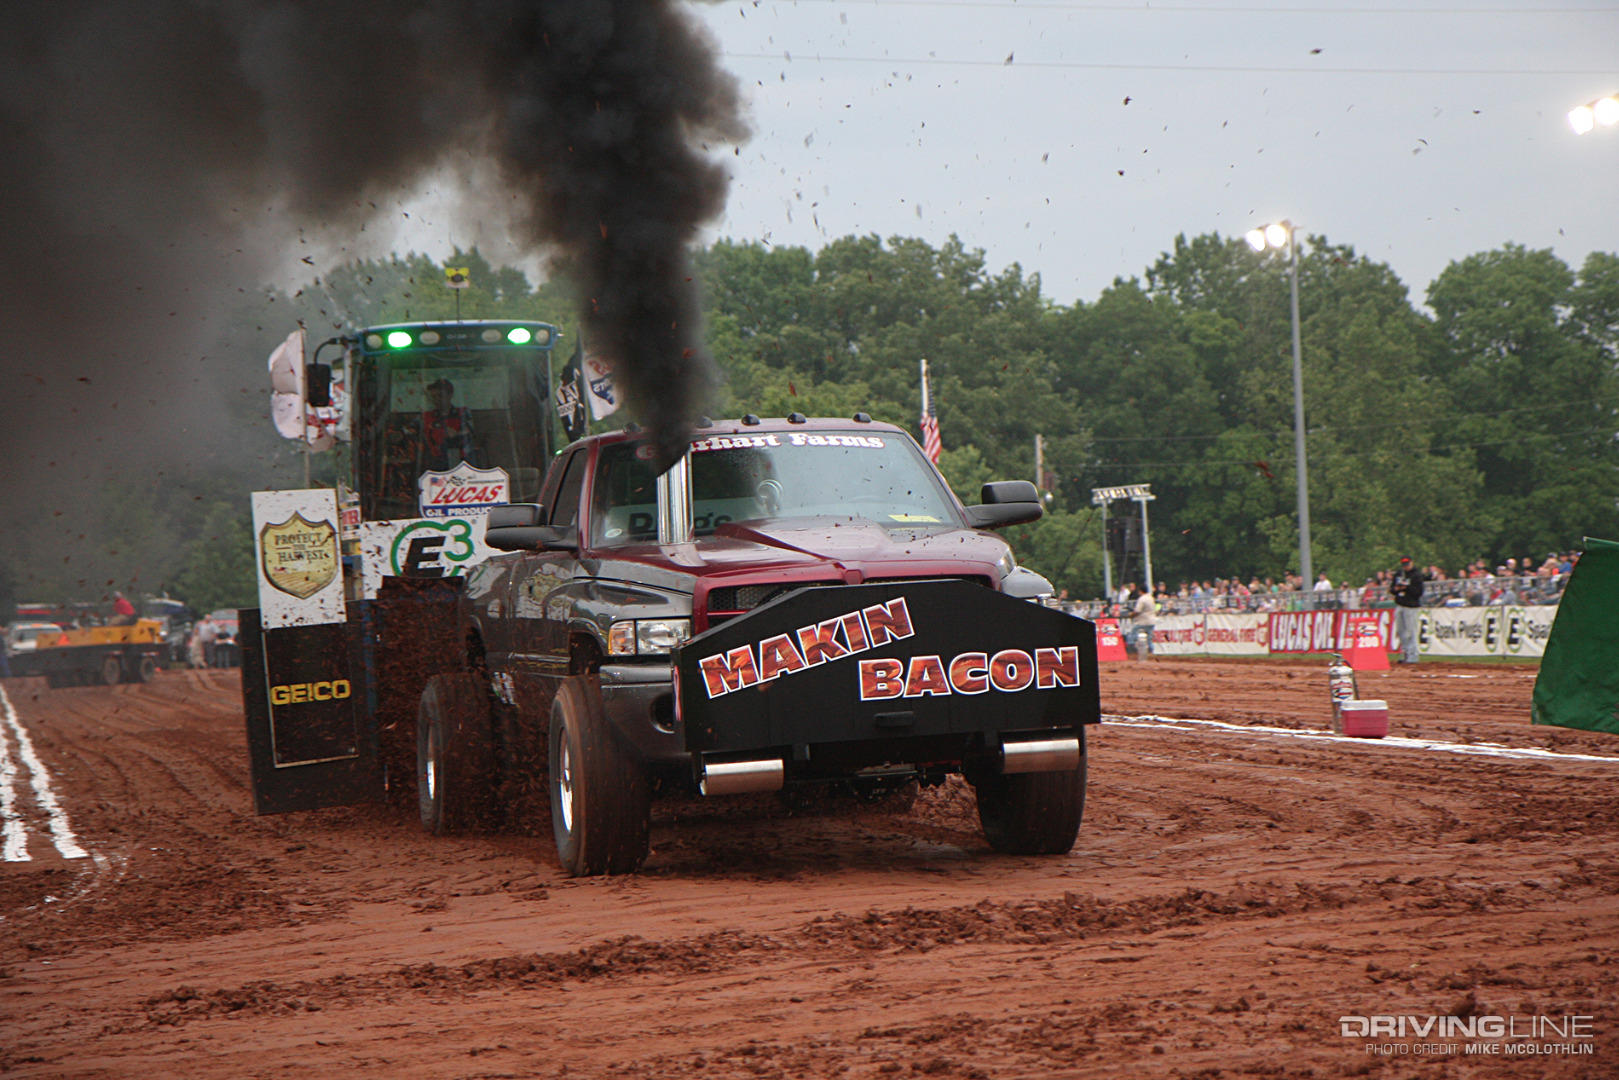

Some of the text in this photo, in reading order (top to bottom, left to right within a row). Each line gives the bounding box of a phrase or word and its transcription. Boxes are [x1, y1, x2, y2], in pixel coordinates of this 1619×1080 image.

[690, 432, 885, 452] rhart Farms
[431, 485, 504, 504] LUCAS
[425, 506, 492, 518] OIL PRODUC
[274, 532, 322, 546] PROTECT
[391, 519, 475, 578] E3
[277, 549, 325, 563] HARVEST
[1271, 612, 1313, 651] LUCAS
[1313, 611, 1336, 650] OIL
[699, 597, 916, 699] MAKIN
[1358, 636, 1379, 648] 200
[858, 646, 1081, 701] BACON
[270, 679, 352, 706] GEICO
